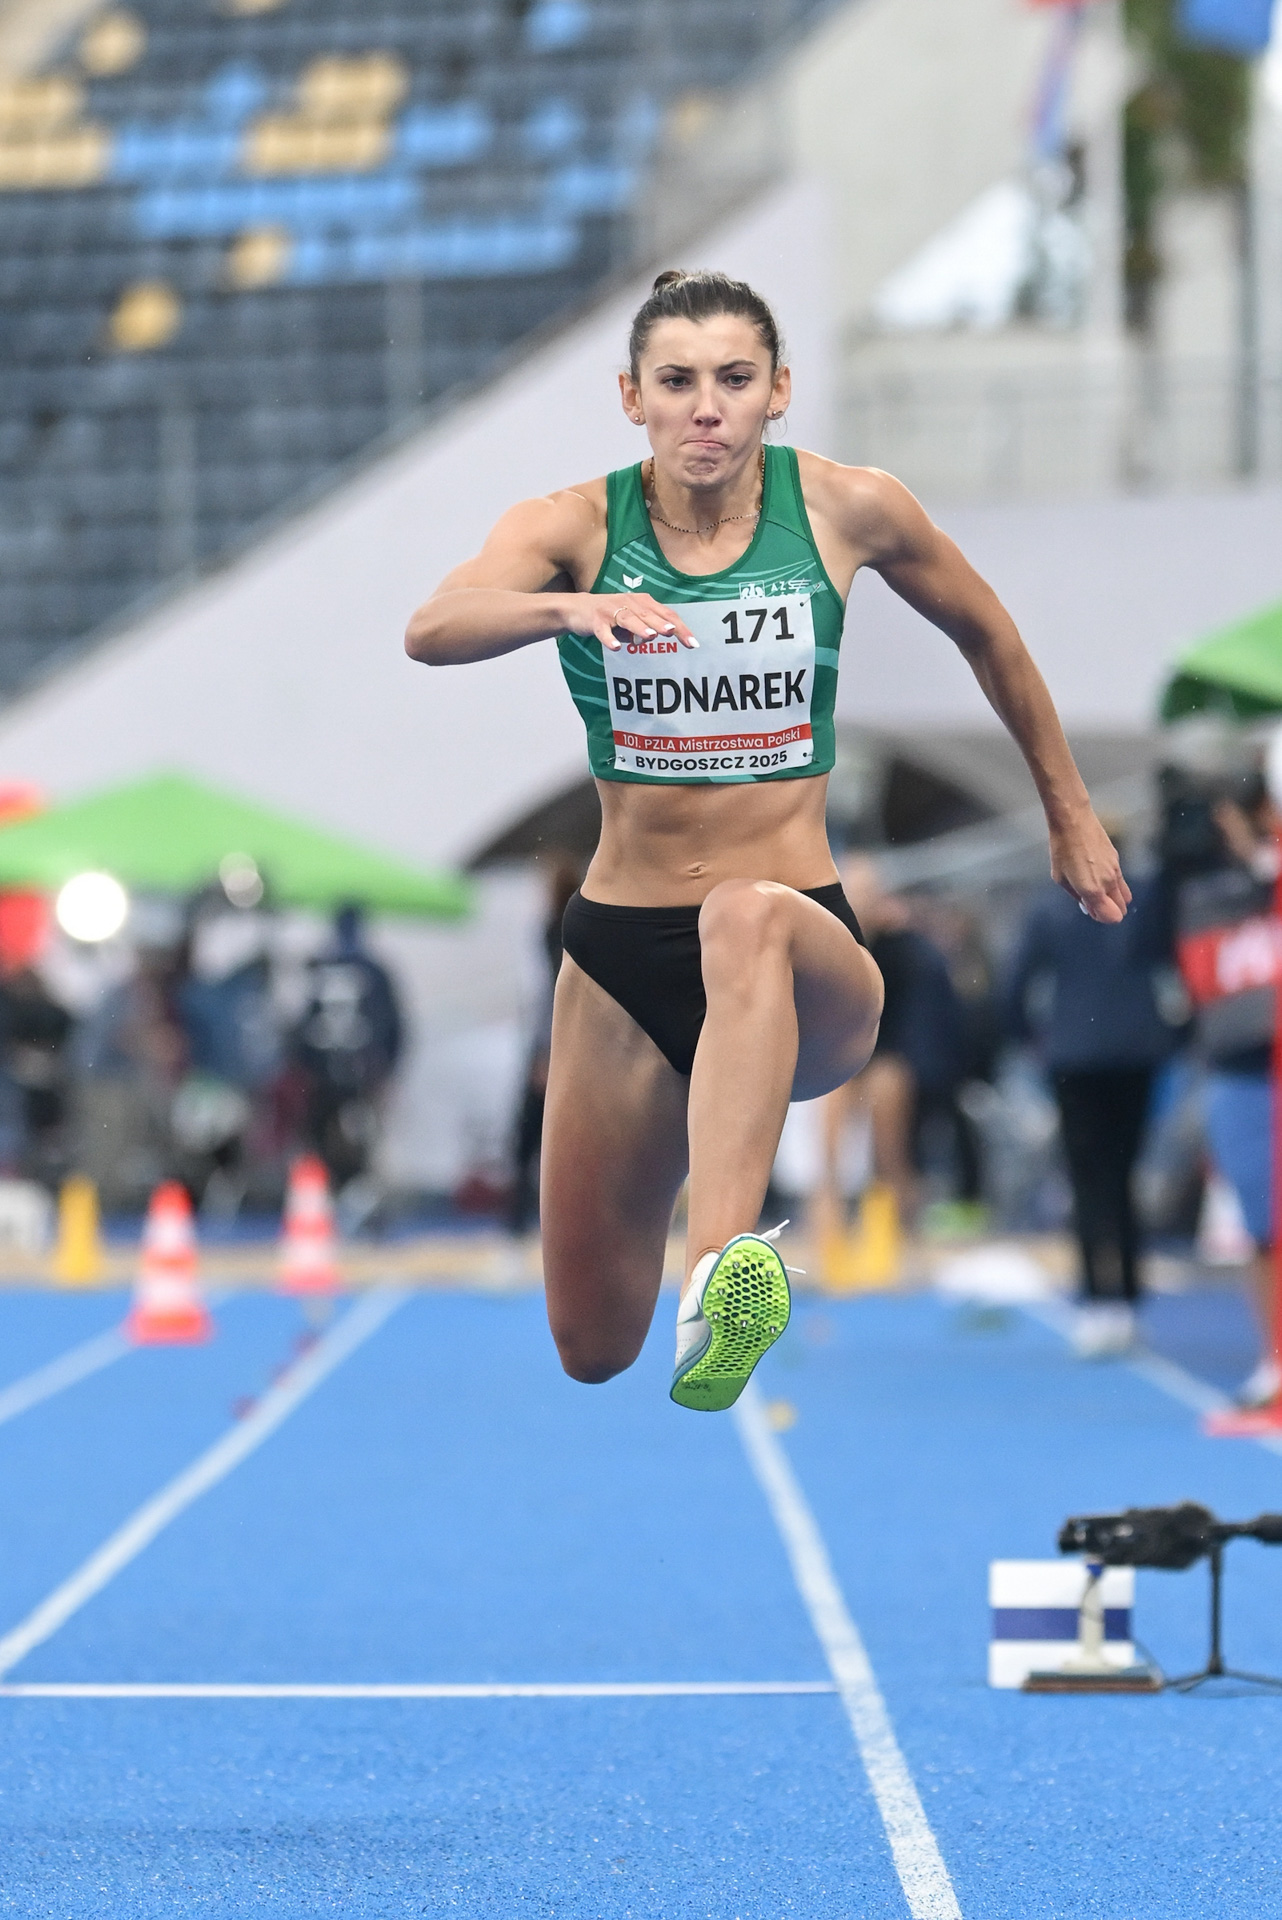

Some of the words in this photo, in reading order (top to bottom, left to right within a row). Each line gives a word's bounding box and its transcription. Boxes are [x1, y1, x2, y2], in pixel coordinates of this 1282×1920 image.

[721, 607, 794, 644] 171
[627, 642, 677, 654] ORLEN
[612, 669, 806, 714] BEDNAREK
[623, 734, 641, 748] 101.
[644, 738, 676, 751] PZLA
[679, 737, 763, 751] Mistrzostwa
[768, 728, 800, 747] Polski
[635, 755, 744, 771] BYDGOSZCZ
[749, 750, 787, 767] 2025
